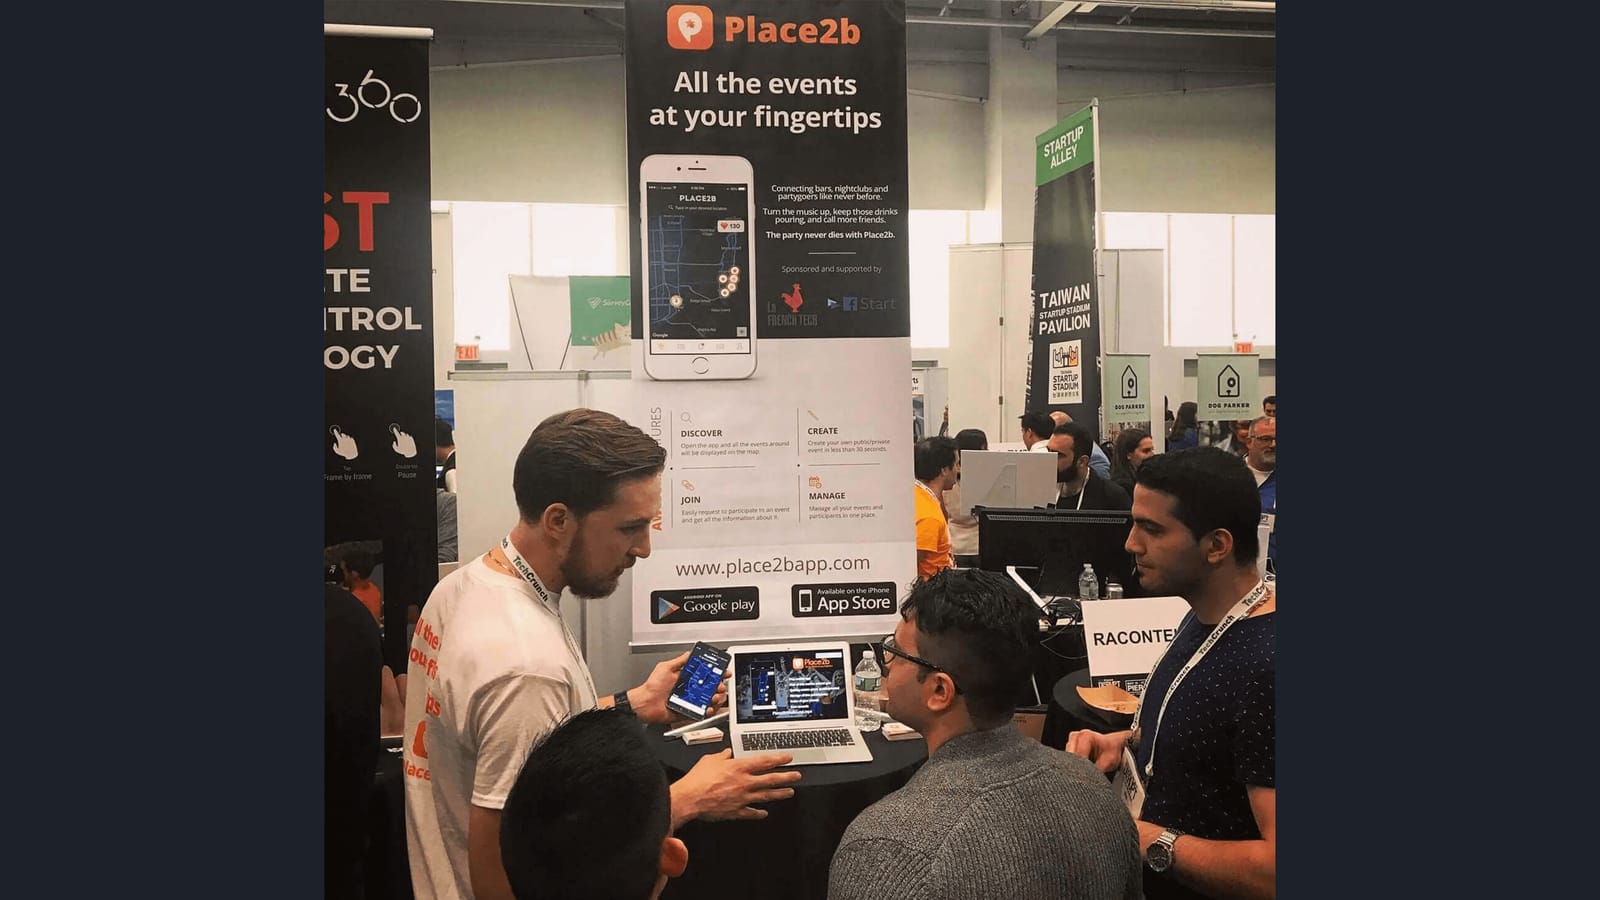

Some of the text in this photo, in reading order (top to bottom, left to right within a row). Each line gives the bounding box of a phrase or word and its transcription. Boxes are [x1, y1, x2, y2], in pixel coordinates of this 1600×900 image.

[725, 16, 861, 44] Place2b
[674, 71, 857, 95] All the events
[326, 69, 421, 123] 360
[650, 106, 881, 134] at your fingertips
[1044, 125, 1084, 157] STARTUP
[1050, 143, 1078, 169] ALLEY
[771, 185, 889, 194] Connecting bars, nightclubs and
[778, 193, 818, 202] partygoers
[775, 216, 806, 225] pouring,
[820, 209, 832, 217] up,
[833, 208, 851, 217] keep
[875, 207, 899, 215] drinks
[782, 231, 804, 240] party
[781, 265, 820, 273] Sponsored
[836, 265, 871, 273] supported
[873, 265, 882, 274] by
[324, 268, 371, 293] TE
[860, 298, 897, 310] Start
[1039, 283, 1091, 309] TAIWAN
[324, 306, 422, 331] TROL
[1039, 303, 1091, 320] STARTUP STADIUM
[1039, 313, 1091, 335] PAVILION
[1053, 374, 1079, 383] STARTUP
[1053, 382, 1079, 391] STADIUM
[681, 430, 723, 438] DISCOVER
[808, 427, 839, 435] CREATE
[681, 496, 701, 505] JOIN
[809, 492, 846, 500] MANAGE
[809, 505, 831, 513] Manage
[676, 557, 870, 578] www.place2bapp.com
[513, 555, 549, 602] TechCrunch
[683, 599, 756, 615] Google play
[817, 595, 891, 614] App Store
[424, 621, 440, 651] the
[1198, 615, 1236, 655] TechCrunch
[404, 760, 431, 781] lace
